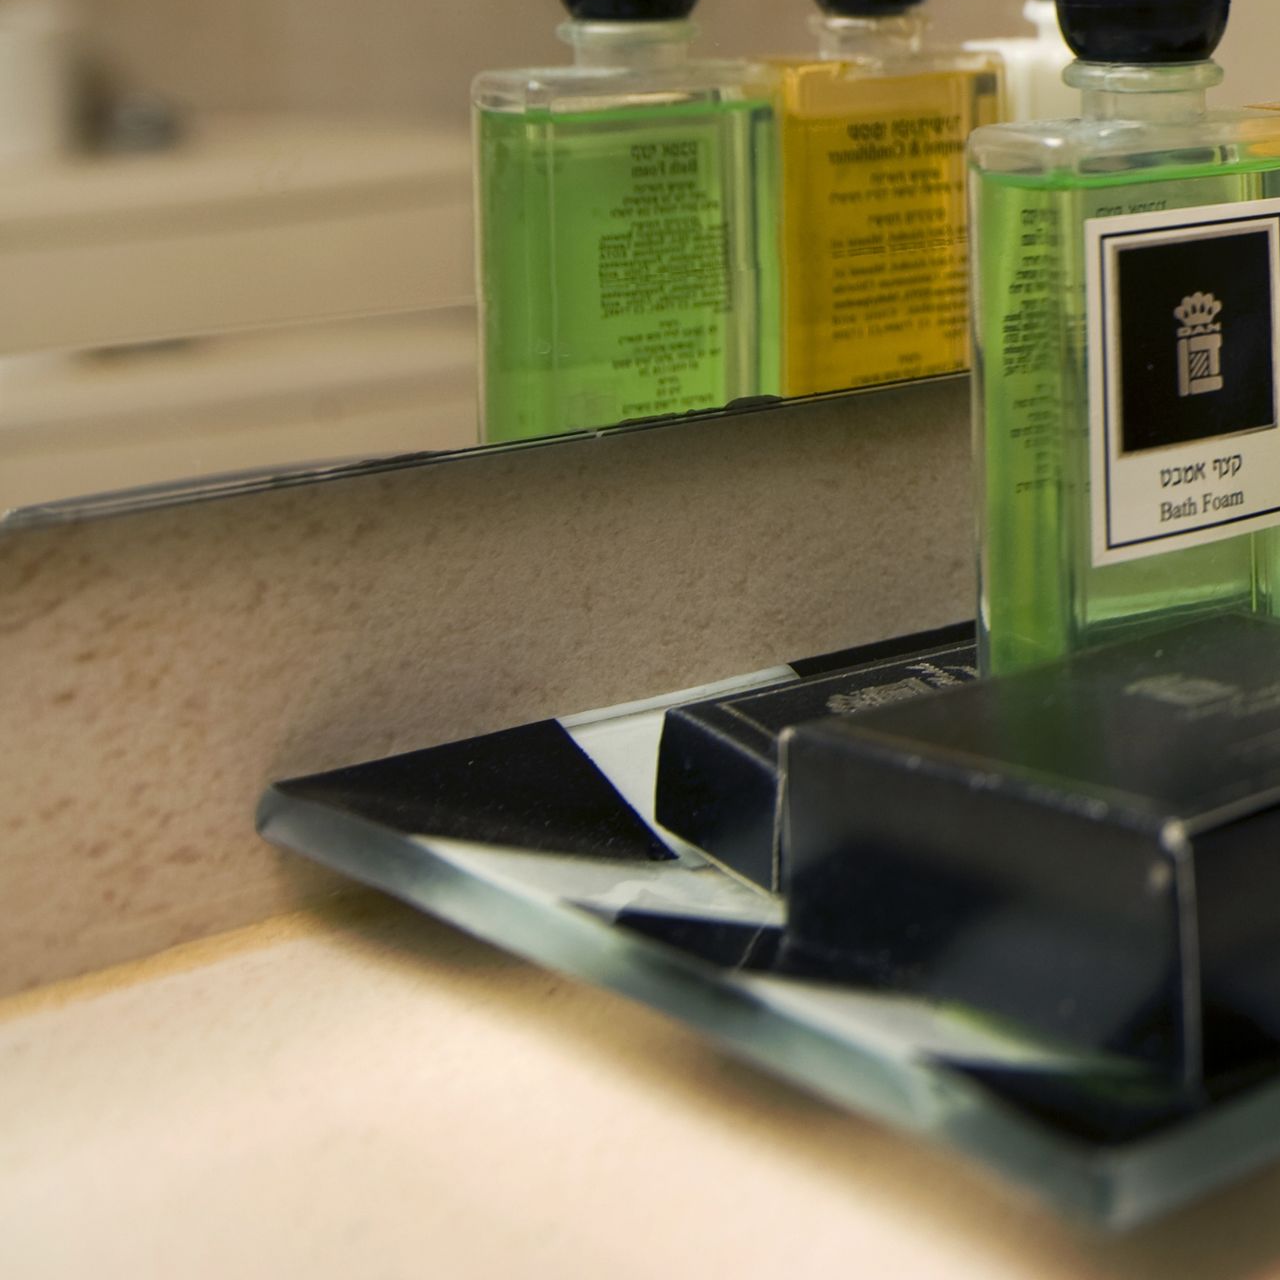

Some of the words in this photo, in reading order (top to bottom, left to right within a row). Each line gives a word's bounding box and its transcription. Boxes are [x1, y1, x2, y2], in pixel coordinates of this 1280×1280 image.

[1160, 461, 1206, 489] אמבט
[1212, 453, 1243, 480] קצף
[1160, 496, 1198, 523] Bath
[1202, 490, 1245, 513] Foam
